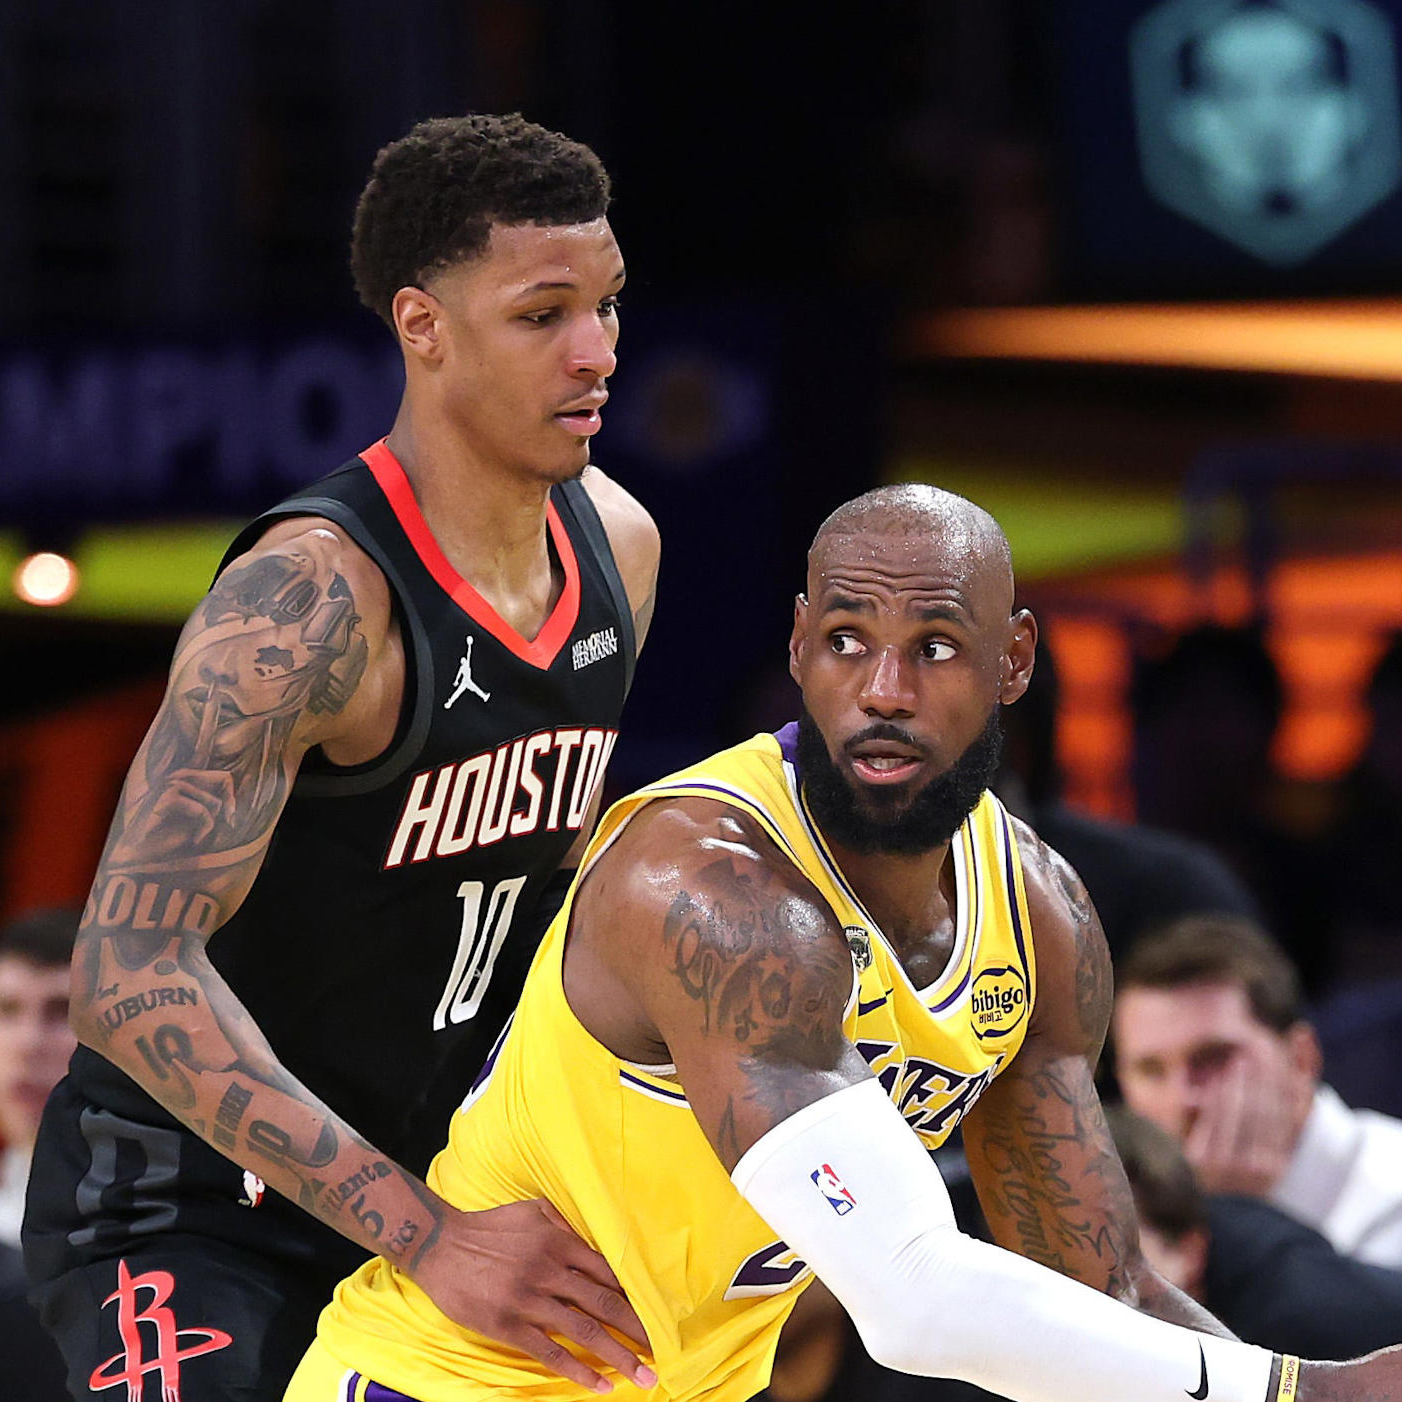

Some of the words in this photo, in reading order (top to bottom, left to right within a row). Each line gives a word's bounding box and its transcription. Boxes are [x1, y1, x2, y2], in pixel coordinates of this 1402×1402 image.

[433, 875, 527, 1031] 10
[971, 985, 1024, 1014] bibigo
[978, 1010, 1004, 1025] 비비고
[350, 1193, 385, 1239] 5
[1282, 1359, 1296, 1396] ROMISE
